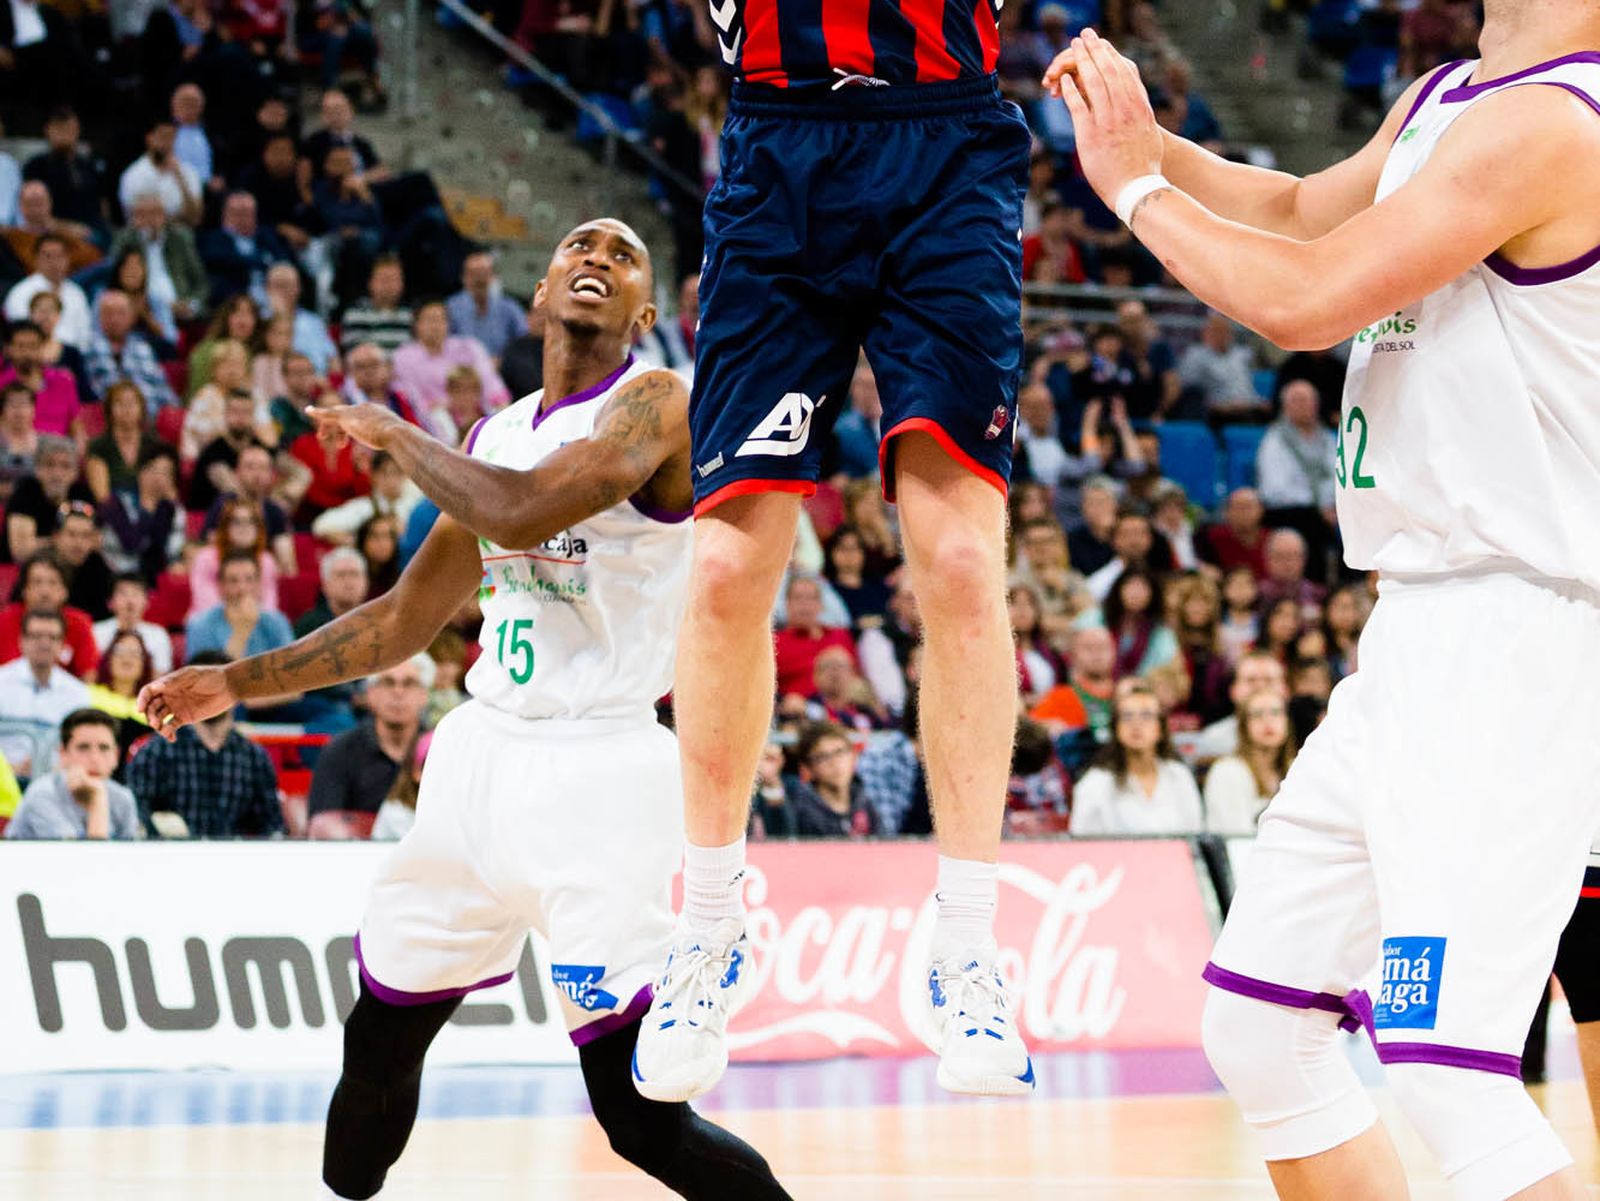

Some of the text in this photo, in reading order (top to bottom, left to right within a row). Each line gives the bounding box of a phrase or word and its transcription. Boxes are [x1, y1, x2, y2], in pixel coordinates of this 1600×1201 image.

[496, 619, 535, 685] 15
[16, 892, 548, 1033] huml
[1380, 983, 1429, 1013] aga
